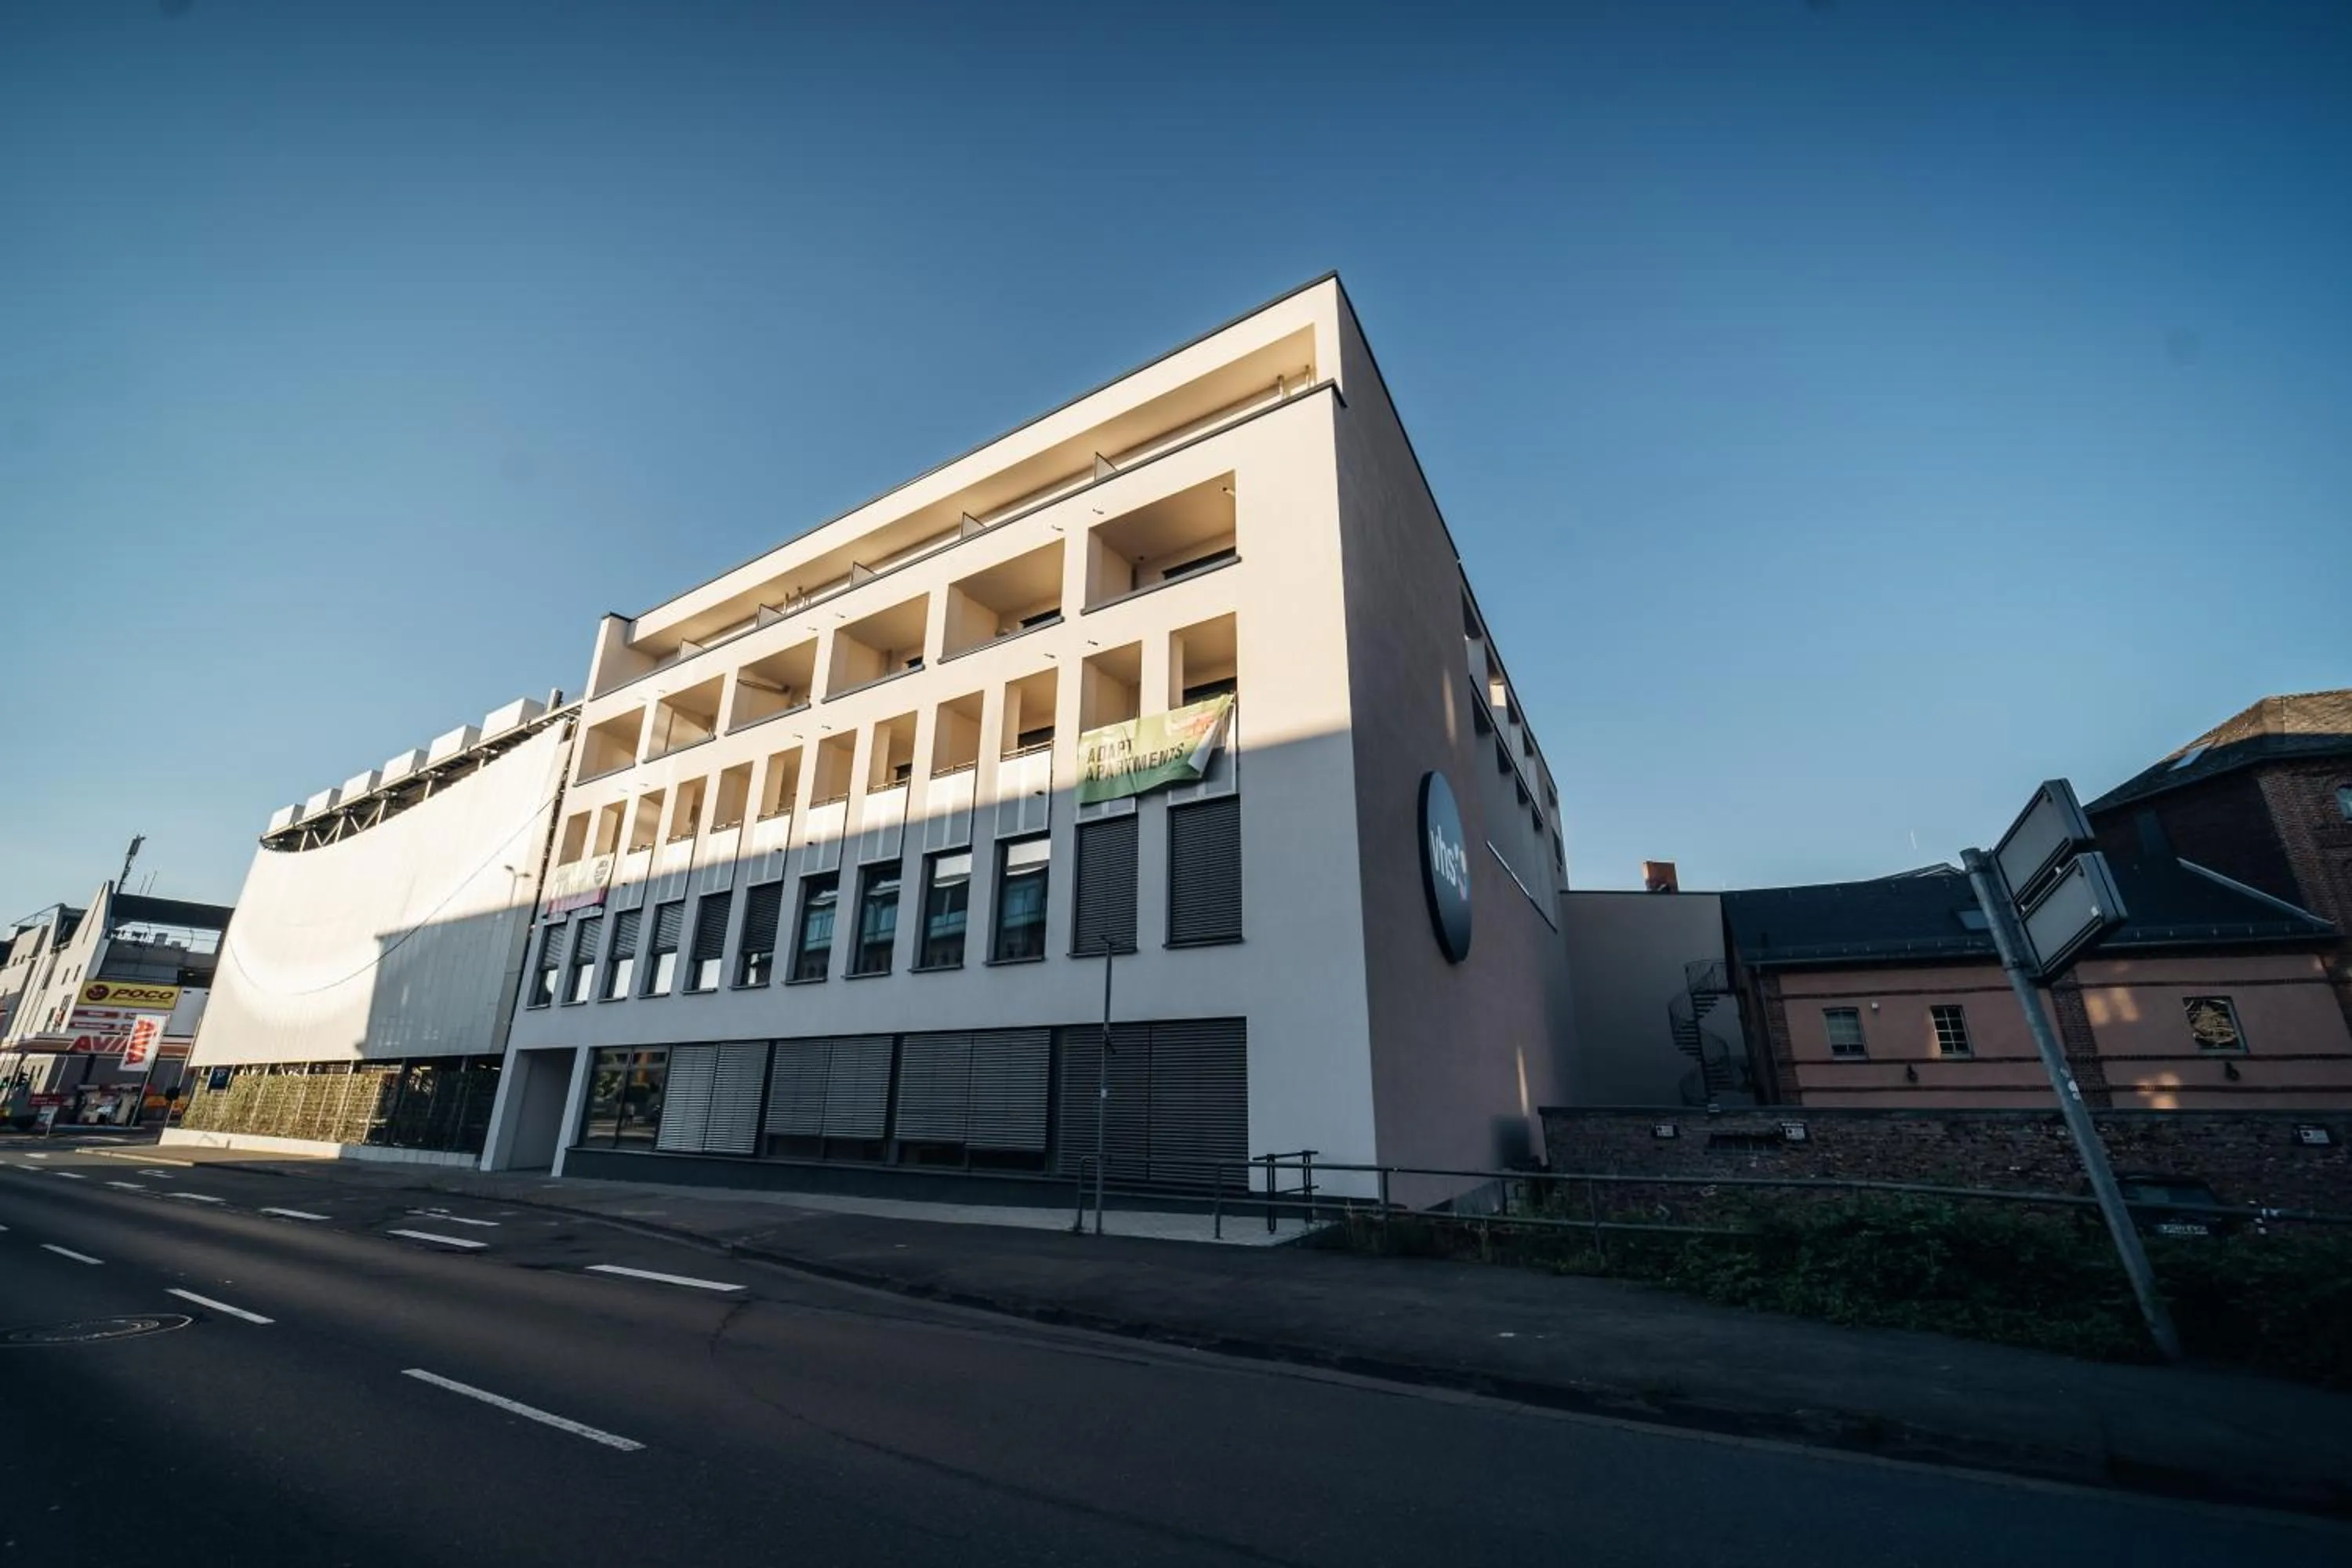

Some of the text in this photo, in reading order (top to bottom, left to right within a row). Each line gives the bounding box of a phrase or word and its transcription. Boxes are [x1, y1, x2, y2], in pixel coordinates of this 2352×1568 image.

[1085, 742, 1185, 782] APARTMENTS
[1087, 739, 1132, 764] ADAPT
[1430, 824, 1456, 887] vhs
[111, 989, 174, 1000] POCO
[67, 1036, 129, 1053] AVI
